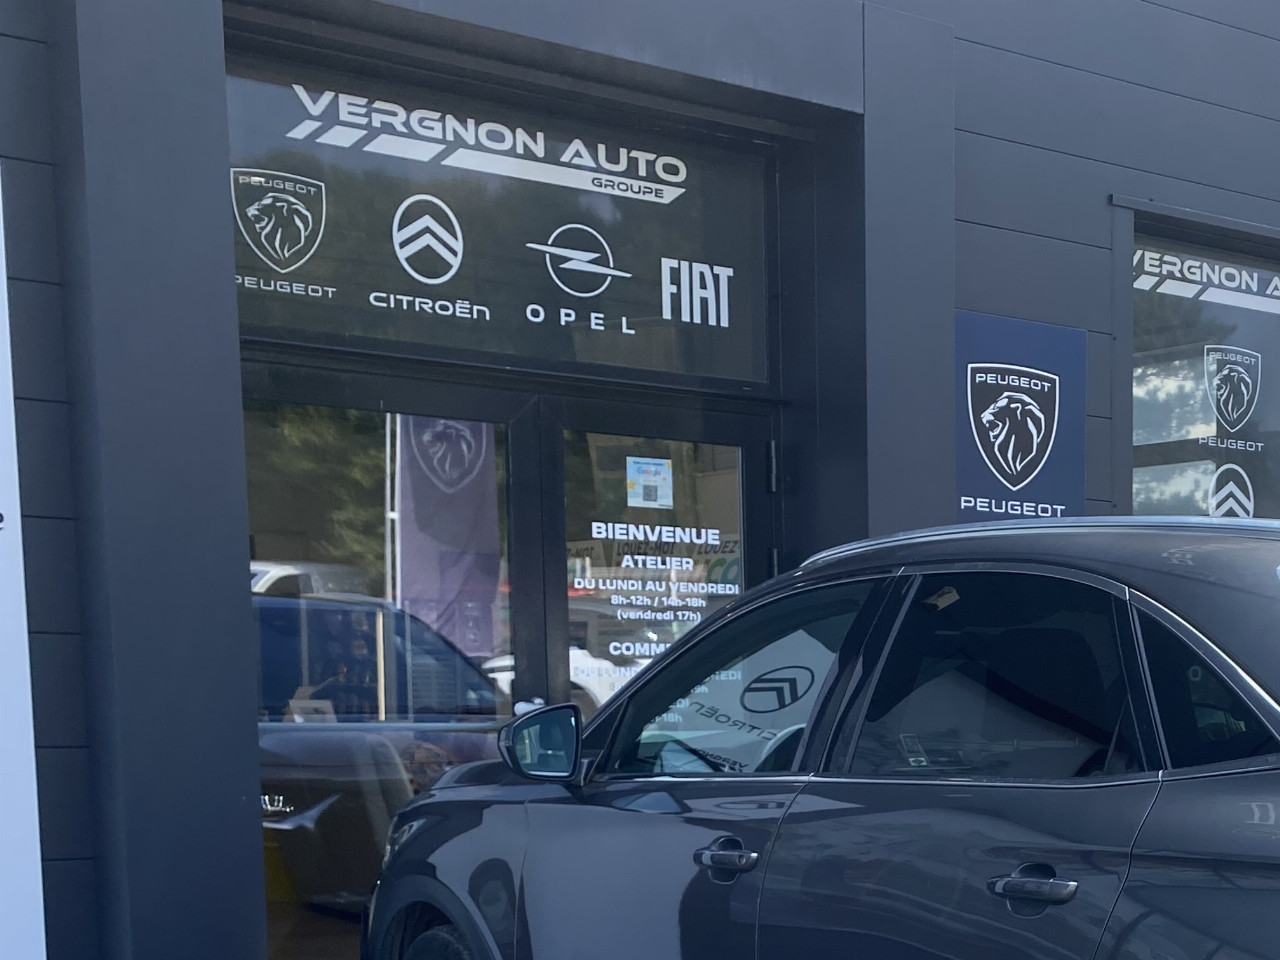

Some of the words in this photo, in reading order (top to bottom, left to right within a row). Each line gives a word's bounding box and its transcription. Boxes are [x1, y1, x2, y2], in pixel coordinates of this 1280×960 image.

[291, 84, 545, 158] VERGNON
[560, 139, 687, 183] AUTO
[239, 175, 317, 195] PEUGEOT
[591, 177, 664, 198] GROUPE
[661, 257, 734, 328] FIAT
[525, 304, 636, 335] OPEL
[1209, 351, 1256, 366] PEUGEOT
[975, 373, 1051, 392] PEUGEOT
[1198, 435, 1264, 452] PEUGEOT
[960, 496, 1065, 517] PEUGEOT
[591, 521, 720, 545] BIENVENUE
[621, 555, 694, 571] ATELIER
[574, 578, 595, 589] DU
[599, 579, 642, 591] LUNDI
[645, 581, 665, 592] AU
[669, 582, 740, 594] VENDREDI
[610, 595, 651, 606] 8h-12h
[663, 597, 706, 608] 14h-18h
[617, 609, 674, 621] (vendredi
[676, 611, 702, 623] 17h)
[609, 641, 671, 656] COMM
